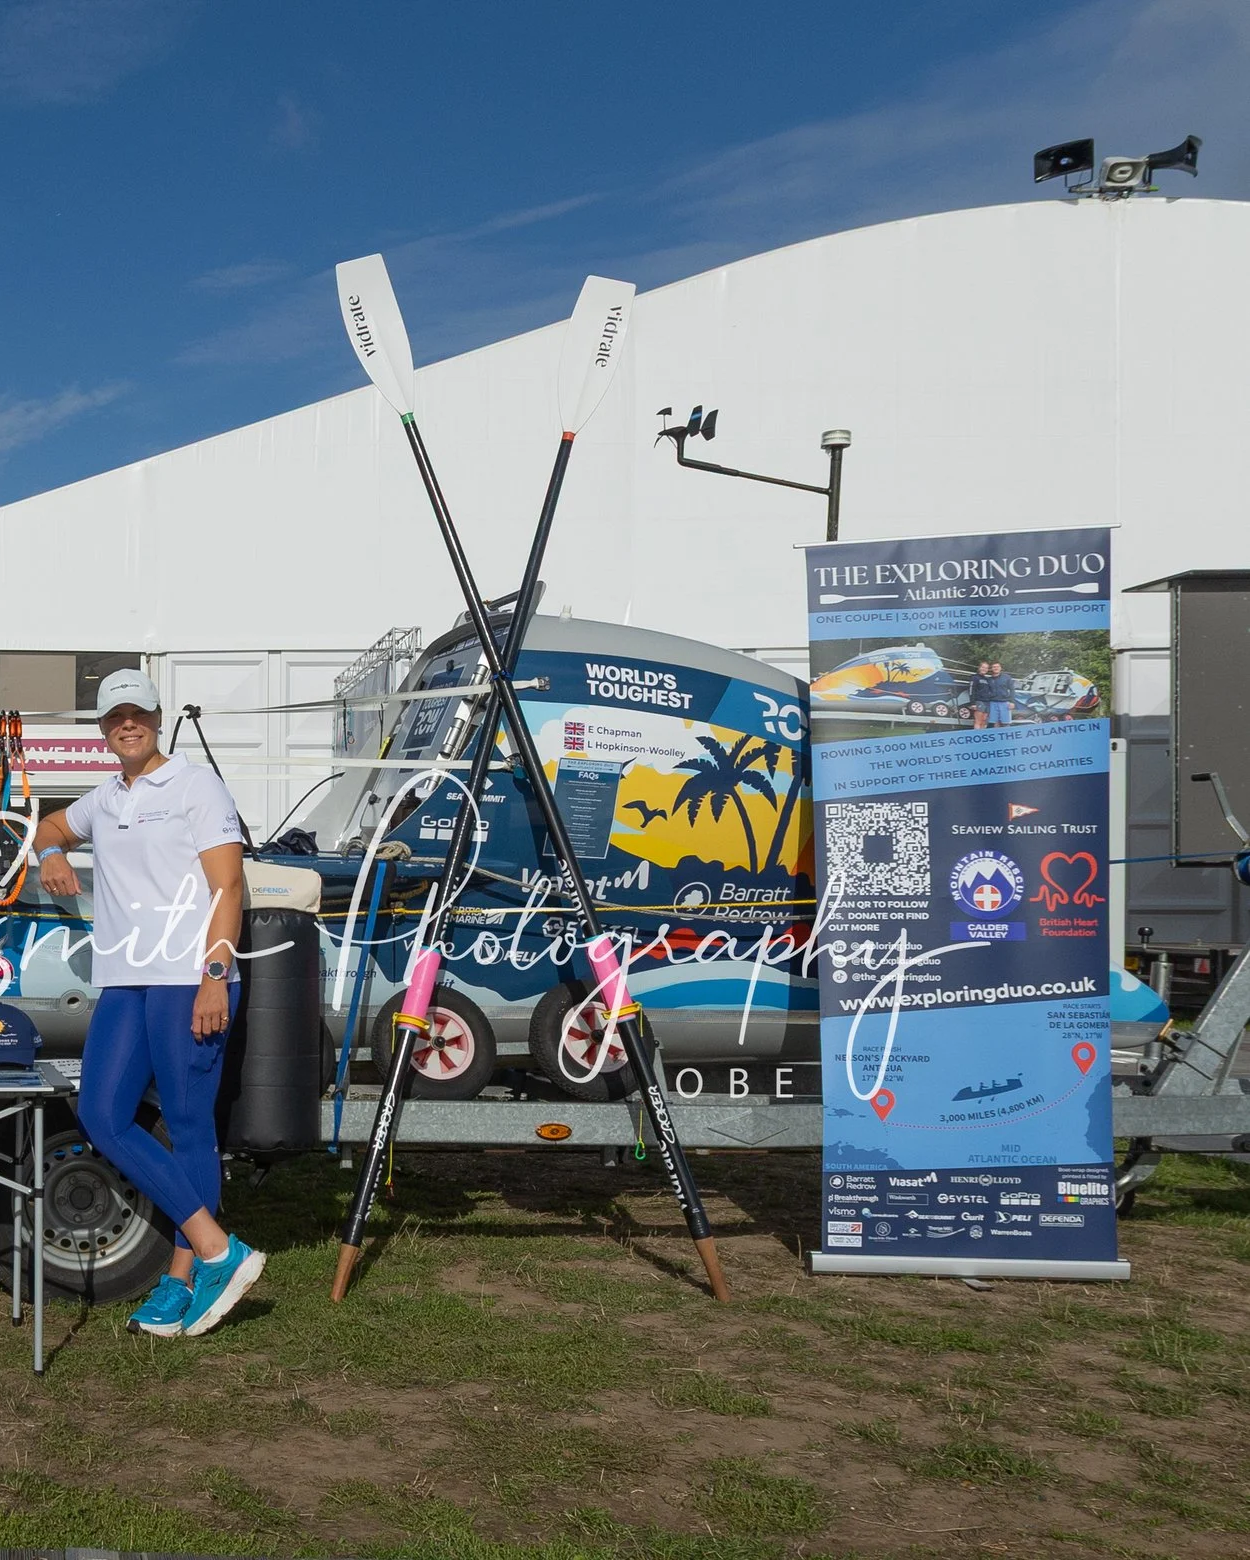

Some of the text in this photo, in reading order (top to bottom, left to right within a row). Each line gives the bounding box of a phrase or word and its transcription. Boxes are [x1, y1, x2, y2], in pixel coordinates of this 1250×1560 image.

[814, 552, 1105, 587] THE EXPLORING DUO
[903, 584, 1010, 602] Atlantic 2026
[816, 603, 1106, 624] ONE COUPLE 3,000 MILE ROW ZERO SUPPORT
[919, 620, 999, 631] ONE MISSION
[585, 663, 677, 690] WORLD'S
[586, 680, 693, 709] TOUGHEST
[597, 726, 642, 738] Chapman
[821, 722, 1101, 760] ROWING 3,000 MILES ACROSS THE ATLANTIC IN
[588, 741, 686, 758] L Hopkinson-Woolley
[72, 747, 121, 764] HAL
[869, 743, 1053, 771] THE WORLD'S TOUGHEST ROW
[578, 771, 599, 780] FAQs
[834, 756, 1094, 791] IN SUPPORT OF THREE AMAZING CHARITIES
[421, 816, 489, 830] Goo
[951, 823, 1097, 834] SEAVIEW SAILING TRUST
[950, 850, 1024, 901] MOUNTAIN RESCUE
[719, 883, 791, 902] Barratt
[856, 901, 871, 909] QR
[450, 915, 486, 924] MARINE
[712, 906, 791, 924] Redrow
[848, 912, 888, 920] DONATE
[890, 912, 903, 920] OR
[906, 912, 929, 920] FIND
[1039, 918, 1098, 927] British Heart
[969, 931, 1008, 939] VALLEY
[1042, 928, 1097, 936] Foundation
[835, 1054, 930, 1063] NESON'S OCKYARD
[863, 1064, 902, 1072] ANTGUA
[939, 1094, 1045, 1124] 3,000 MILES (4,800 KM)
[1001, 1144, 1021, 1152] MID
[968, 1155, 1057, 1163] ATLANTIC OCEAN
[846, 1175, 875, 1183] Barratt
[889, 1176, 924, 1187] Viasat
[950, 1176, 1022, 1184] HENRI LLOYD
[1057, 1182, 1109, 1195] Bluelite
[834, 1194, 879, 1203] Breakthrough
[949, 1194, 989, 1204] SYSTEL
[1080, 1197, 1109, 1206] GRAPHICS
[828, 1207, 856, 1216] vismo
[961, 1212, 985, 1221] Gurit
[1011, 1214, 1032, 1222] PELI
